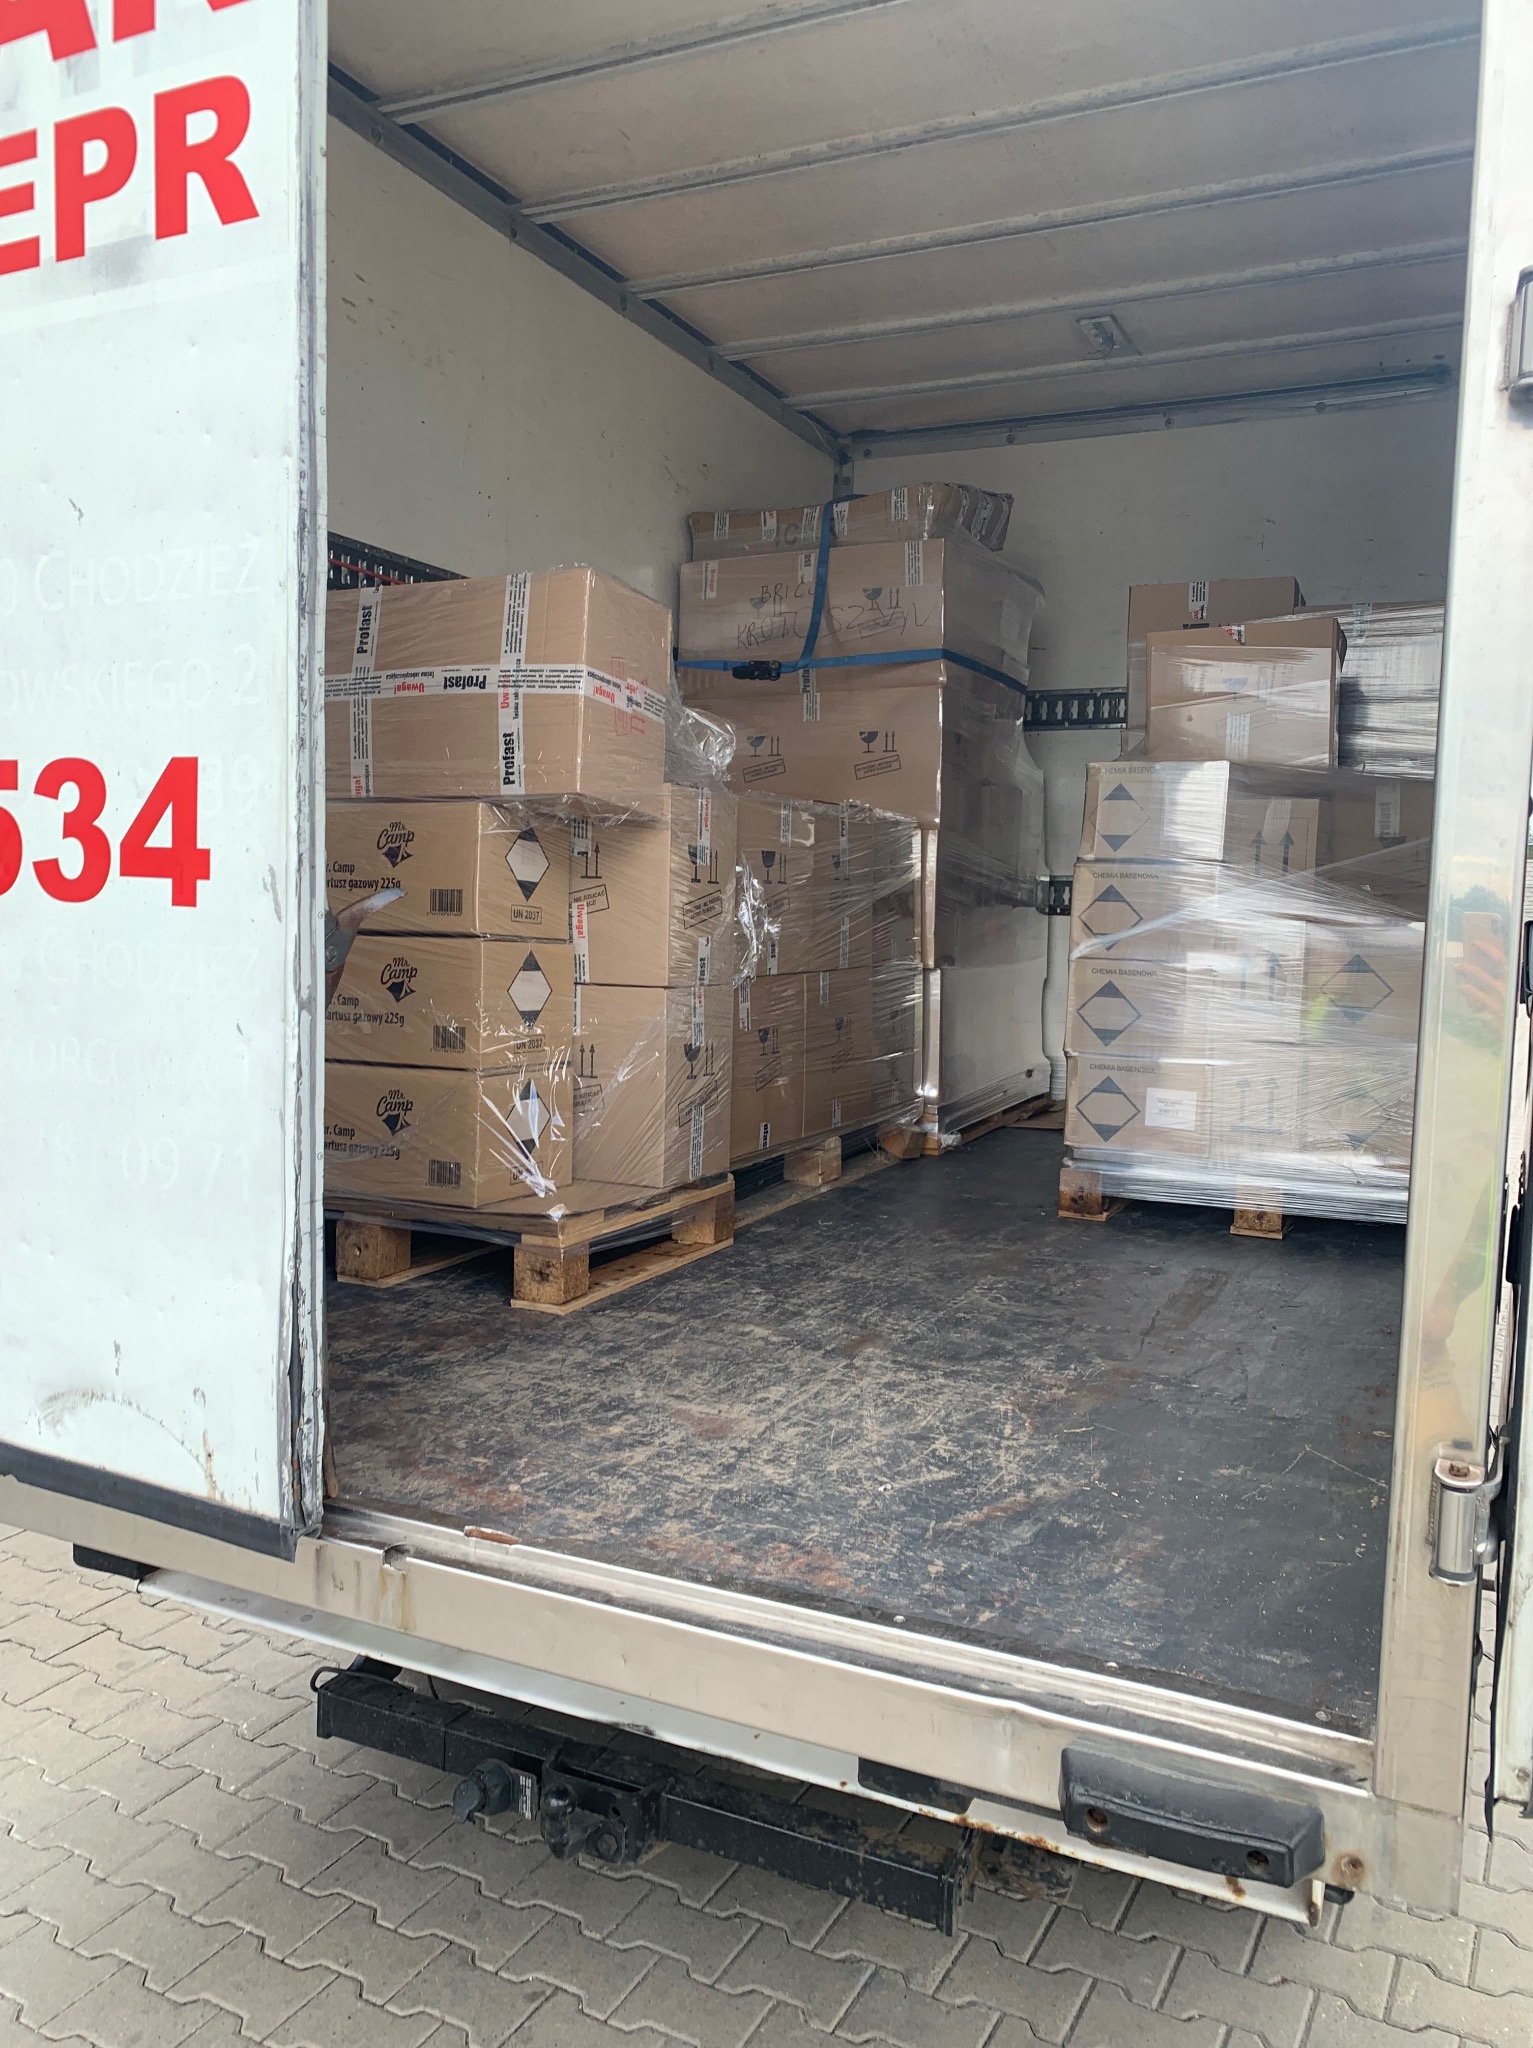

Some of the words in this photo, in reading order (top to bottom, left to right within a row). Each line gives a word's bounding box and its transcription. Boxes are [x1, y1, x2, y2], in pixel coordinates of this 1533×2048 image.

[356, 604, 373, 655] Profast
[394, 681, 425, 694] Uwaga!
[443, 675, 487, 690] Profast
[593, 685, 616, 704] Uwaga!
[502, 732, 516, 786] Profast
[376, 829, 415, 851] Camp
[332, 860, 355, 875] Camp
[1092, 871, 1119, 880] CHEMIA
[1119, 872, 1159, 881] BASENOWA
[348, 878, 379, 891] gazowy
[513, 908, 524, 919] UN
[524, 909, 540, 921] 2037
[575, 903, 586, 939] Uwaga!
[392, 956, 410, 968] Mr.
[380, 963, 418, 985] Camp
[1091, 966, 1117, 976] CHEMIA
[1118, 968, 1158, 977] BASENOWA
[337, 994, 360, 1007] Camp
[352, 1011, 383, 1027] gazowy
[384, 1011, 405, 1027] 225g
[527, 1038, 543, 1050] 2037
[1089, 1062, 1116, 1072] CHEMIA
[388, 1089, 406, 1100] Mr.
[376, 1095, 414, 1117] Camp
[333, 1124, 355, 1140] Camp
